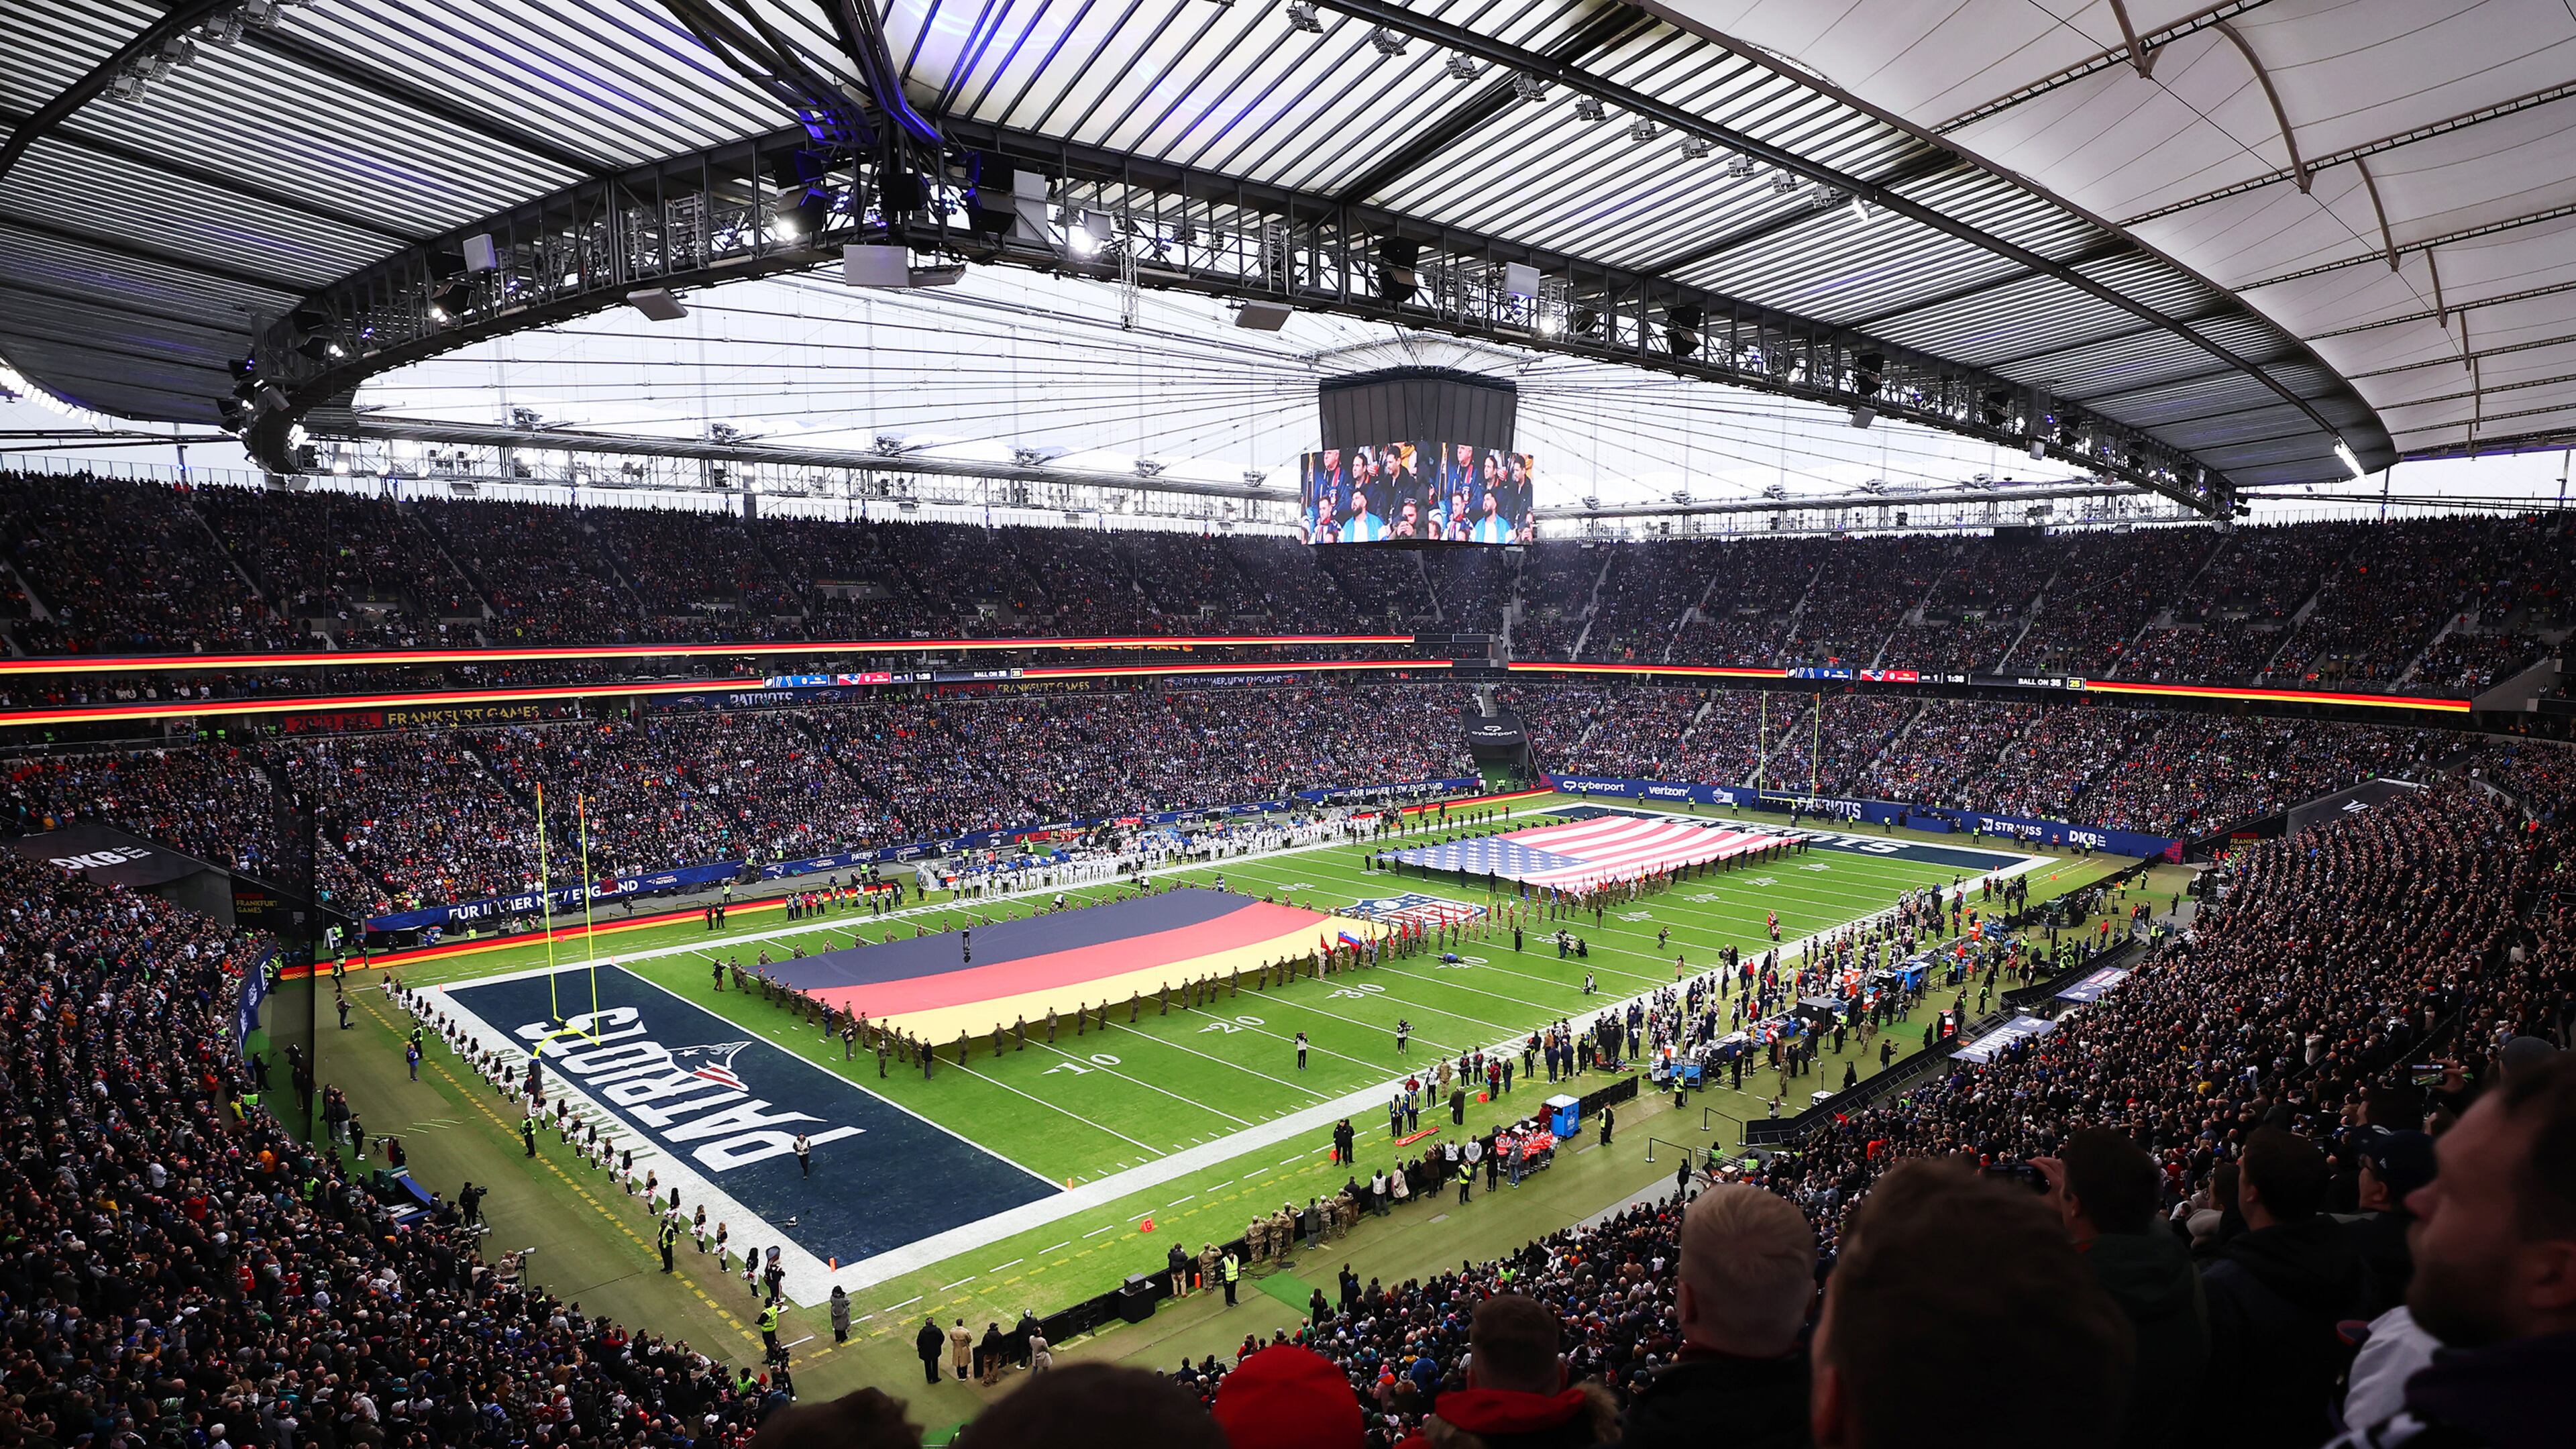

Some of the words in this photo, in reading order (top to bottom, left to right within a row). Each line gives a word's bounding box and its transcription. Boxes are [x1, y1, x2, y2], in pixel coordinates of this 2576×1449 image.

[2037, 678, 2049, 686] ON
[2049, 679, 2061, 687] 35
[1350, 787, 1365, 798] FÜR
[1648, 786, 1687, 797] verizon
[2068, 830, 2097, 845] DKB
[49, 851, 128, 870] DKB
[815, 860, 836, 868] PATRIOTS
[655, 876, 678, 885] PATRIOTS
[449, 904, 479, 920] FÜR
[1334, 983, 1386, 1000] 30
[1208, 1015, 1266, 1034] 20
[1055, 1053, 1122, 1076] 10
[515, 1006, 867, 1173] PATRIOTS
[1144, 1220, 1152, 1231] G
